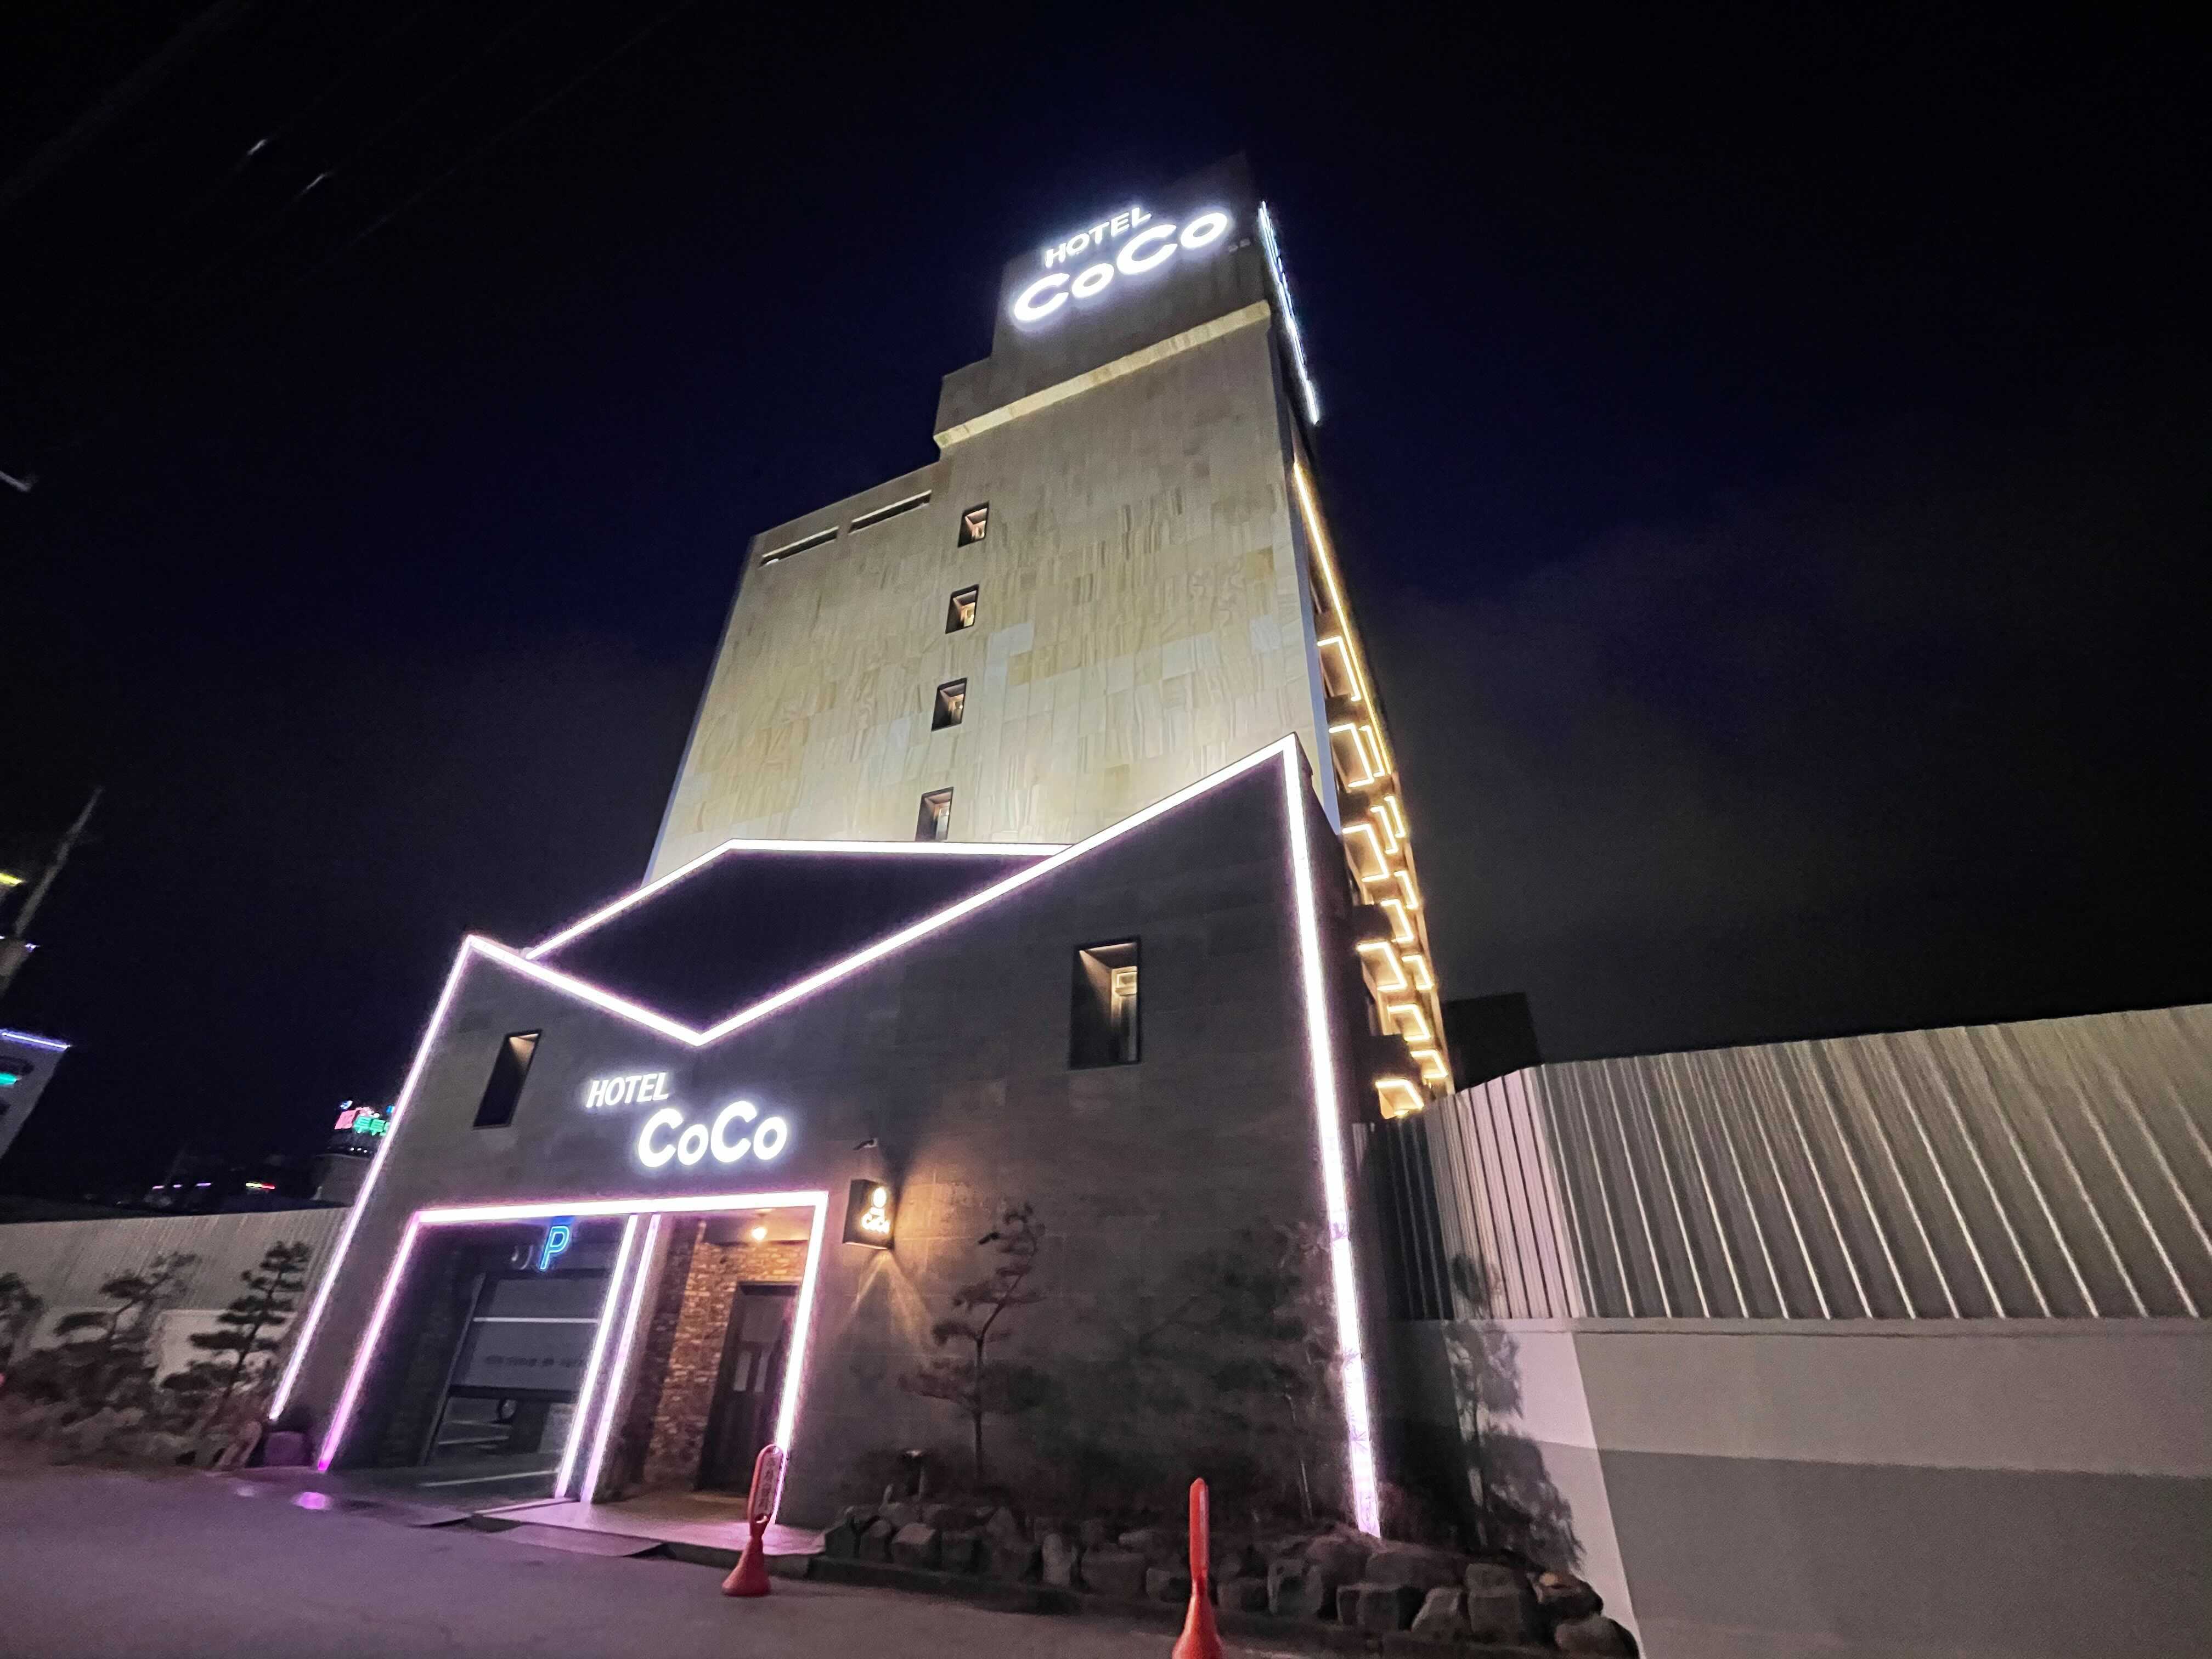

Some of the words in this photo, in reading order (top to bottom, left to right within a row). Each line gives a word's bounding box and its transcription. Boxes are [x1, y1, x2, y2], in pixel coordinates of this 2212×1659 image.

[1014, 212, 1228, 322] CoCo
[1045, 207, 1152, 268] HOTEL
[586, 1072, 669, 1108] HOTEL
[637, 1101, 788, 1167] CoCo
[539, 1225, 571, 1271] P
